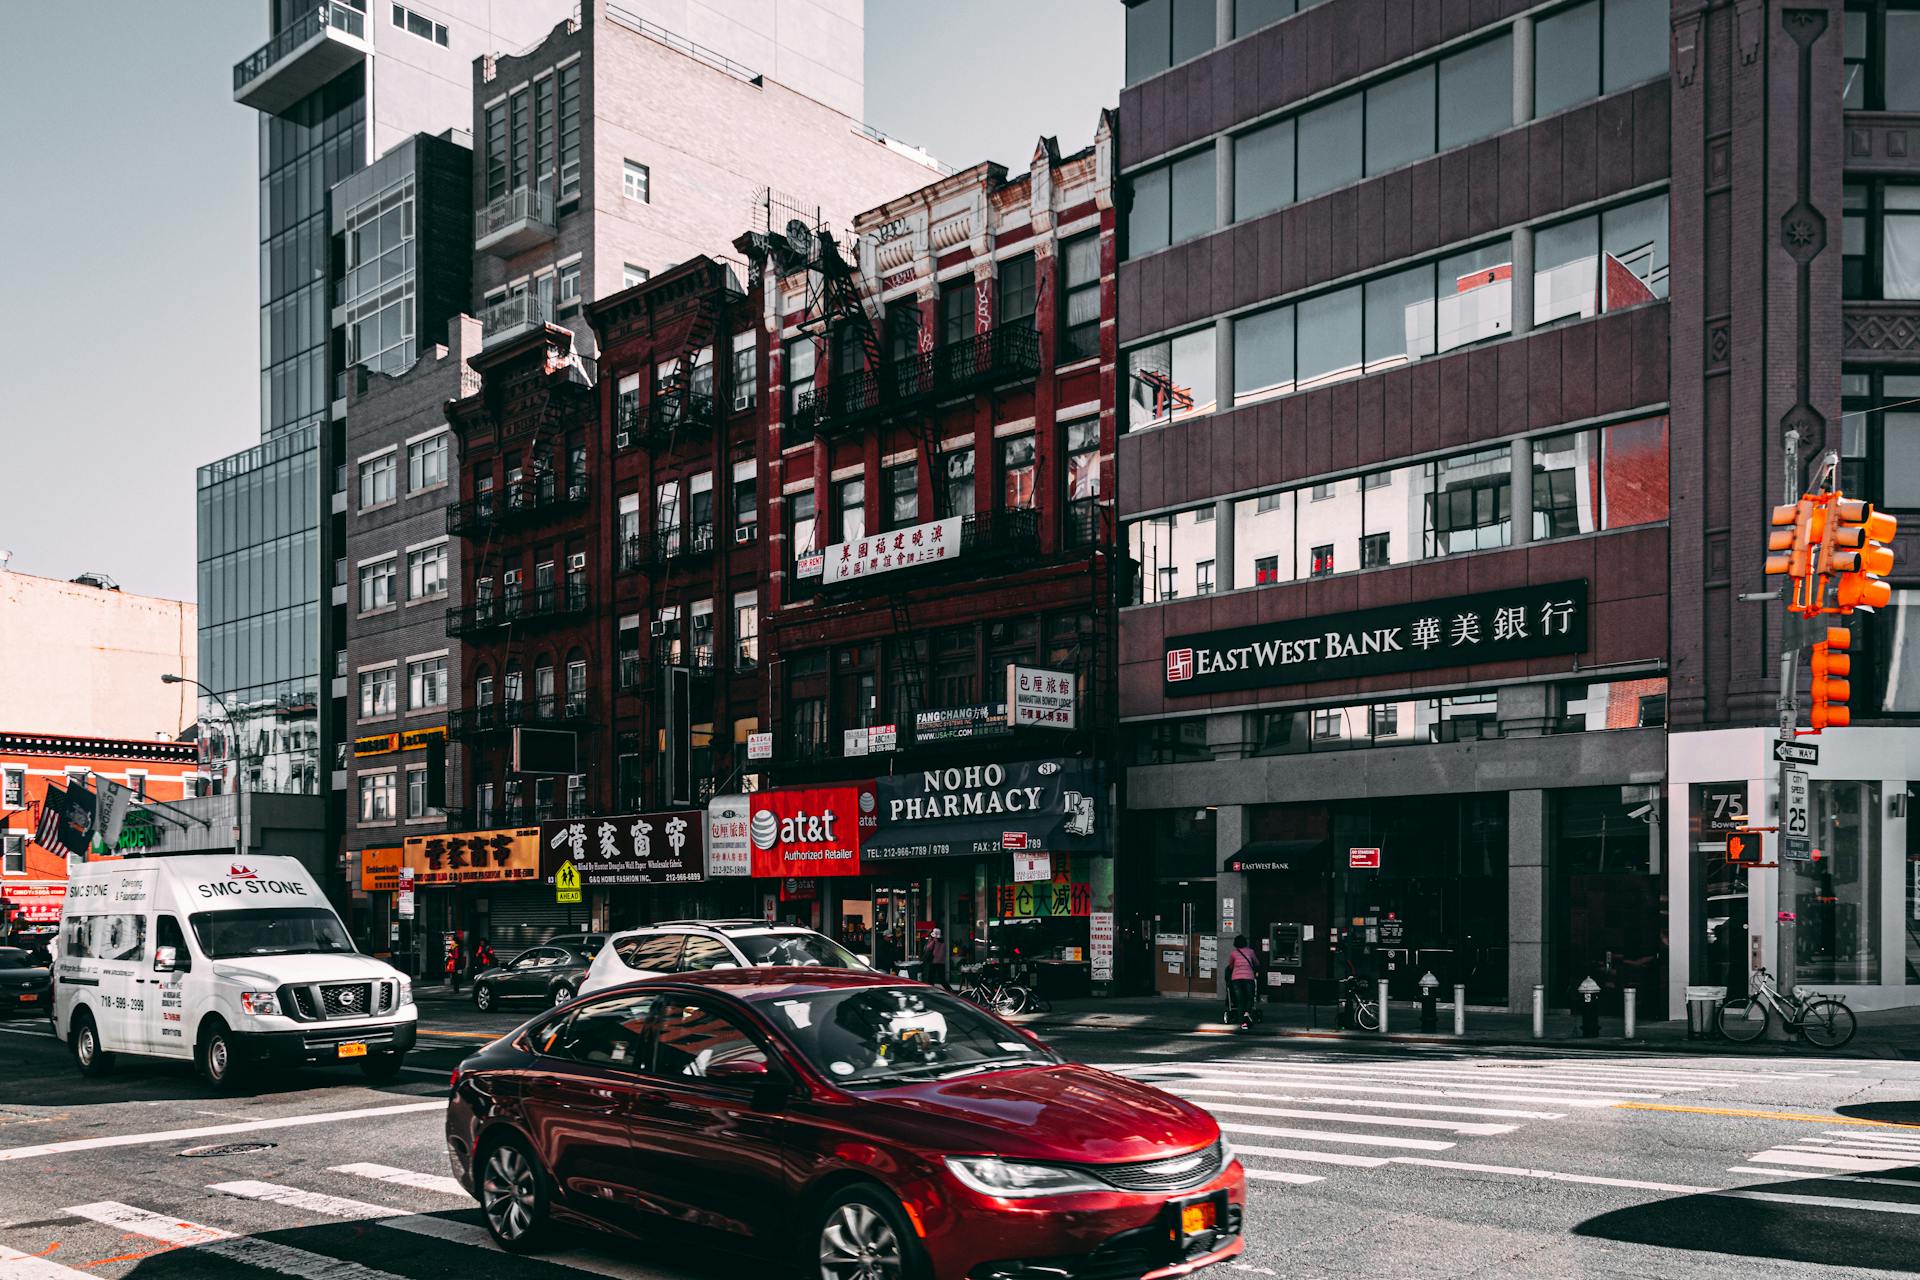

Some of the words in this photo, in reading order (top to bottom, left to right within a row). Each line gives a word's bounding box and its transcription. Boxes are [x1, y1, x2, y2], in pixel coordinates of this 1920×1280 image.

[798, 559, 808, 569] FOR
[809, 557, 823, 567] RENT
[1411, 599, 1574, 650] 華美銀行
[1020, 674, 1070, 694] 包厘旅館
[1018, 693, 1042, 705] MANHATTAN
[1042, 695, 1059, 706] BOWERY
[1059, 697, 1072, 708] LODGE
[916, 708, 972, 724] FANGCHANG
[916, 728, 973, 742] WWW.USA-FC.COM
[1780, 746, 1793, 757] ONE
[1798, 748, 1813, 759] WAY
[1042, 763, 1053, 774] 81
[924, 763, 1003, 793] NOHO
[1792, 775, 1802, 783] CITY
[1791, 785, 1805, 795] SPEED
[890, 786, 1043, 821] PHARMACY
[1711, 793, 1744, 819] 75
[1792, 796, 1804, 804] LIMIT
[780, 809, 834, 843] at&t
[859, 815, 878, 827] at&t
[1789, 807, 1806, 832] 25
[711, 822, 748, 839] 包厘旅館
[867, 848, 882, 858] TEL:
[883, 845, 927, 858] 212-966-7789
[933, 844, 950, 855] 9789
[973, 841, 990, 853] FAX:
[784, 849, 823, 861] Authorized
[824, 849, 853, 860] Retailer
[601, 875, 616, 883] HOME
[616, 874, 639, 883] FASHION
[640, 874, 652, 882] INC.
[665, 872, 701, 882] 212-966-6899
[69, 885, 84, 898] SMC
[85, 884, 109, 897] STONE
[198, 881, 242, 898] SMC
[244, 880, 308, 896] STONE
[559, 892, 579, 900] AHEAD
